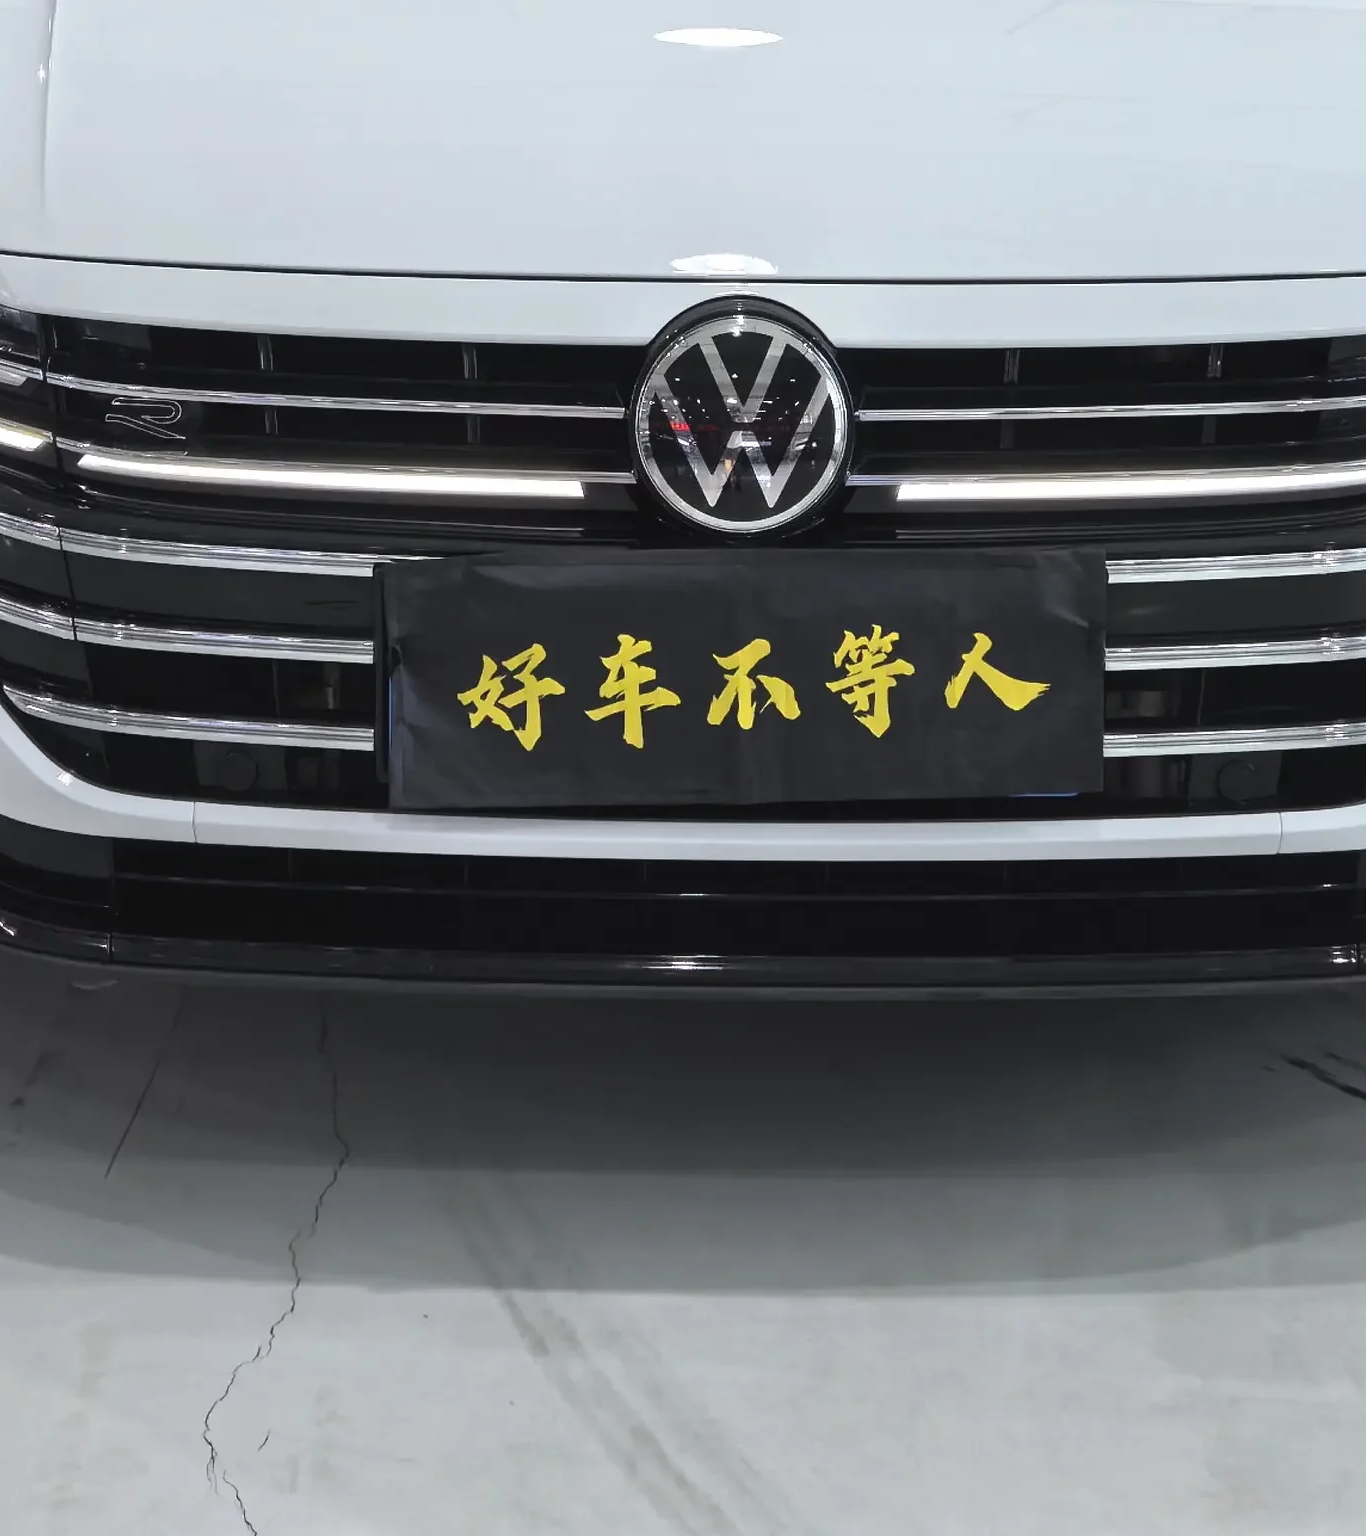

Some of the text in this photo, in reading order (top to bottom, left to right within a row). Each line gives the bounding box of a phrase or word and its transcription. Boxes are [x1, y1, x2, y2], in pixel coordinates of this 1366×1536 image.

[457, 624, 1051, 752] 好车不等人
